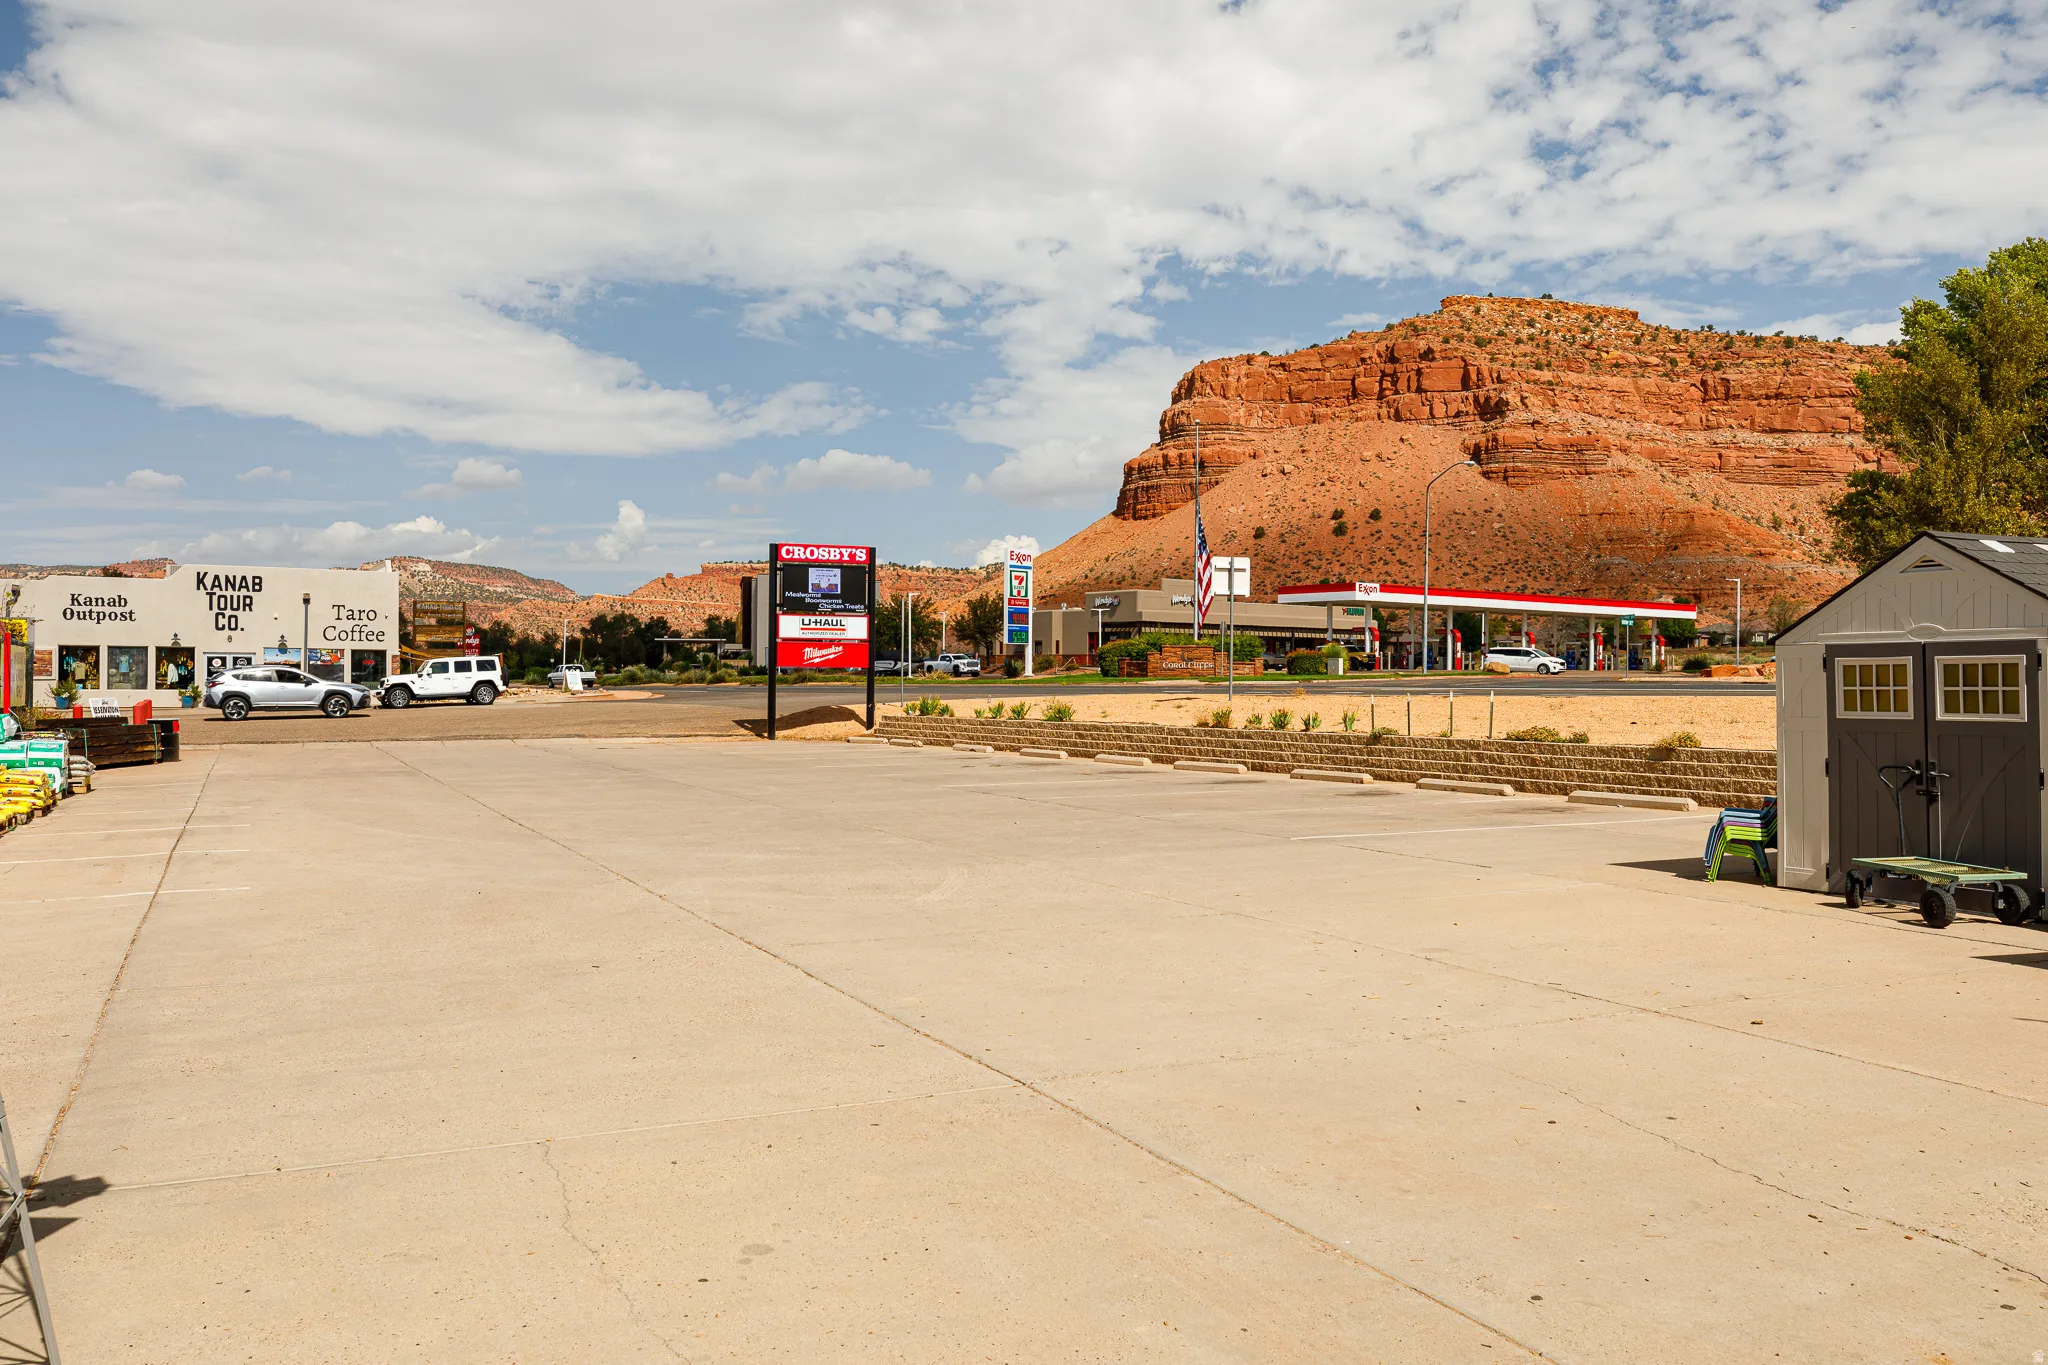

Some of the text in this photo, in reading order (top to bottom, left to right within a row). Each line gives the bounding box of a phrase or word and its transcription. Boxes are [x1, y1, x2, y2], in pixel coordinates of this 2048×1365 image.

[781, 546, 866, 561] CROSBY'S
[1009, 550, 1032, 564] Exxon
[196, 571, 263, 592] KANAB
[1358, 584, 1377, 595] Exxon
[69, 593, 128, 607] Kanab
[205, 592, 254, 612] TOUR
[62, 607, 137, 625] Outpost
[331, 604, 377, 621] Taro
[214, 611, 245, 632] CO.
[801, 618, 846, 627] U-HAUL
[322, 623, 386, 643] Coffee
[802, 644, 844, 661] Milwaukee
